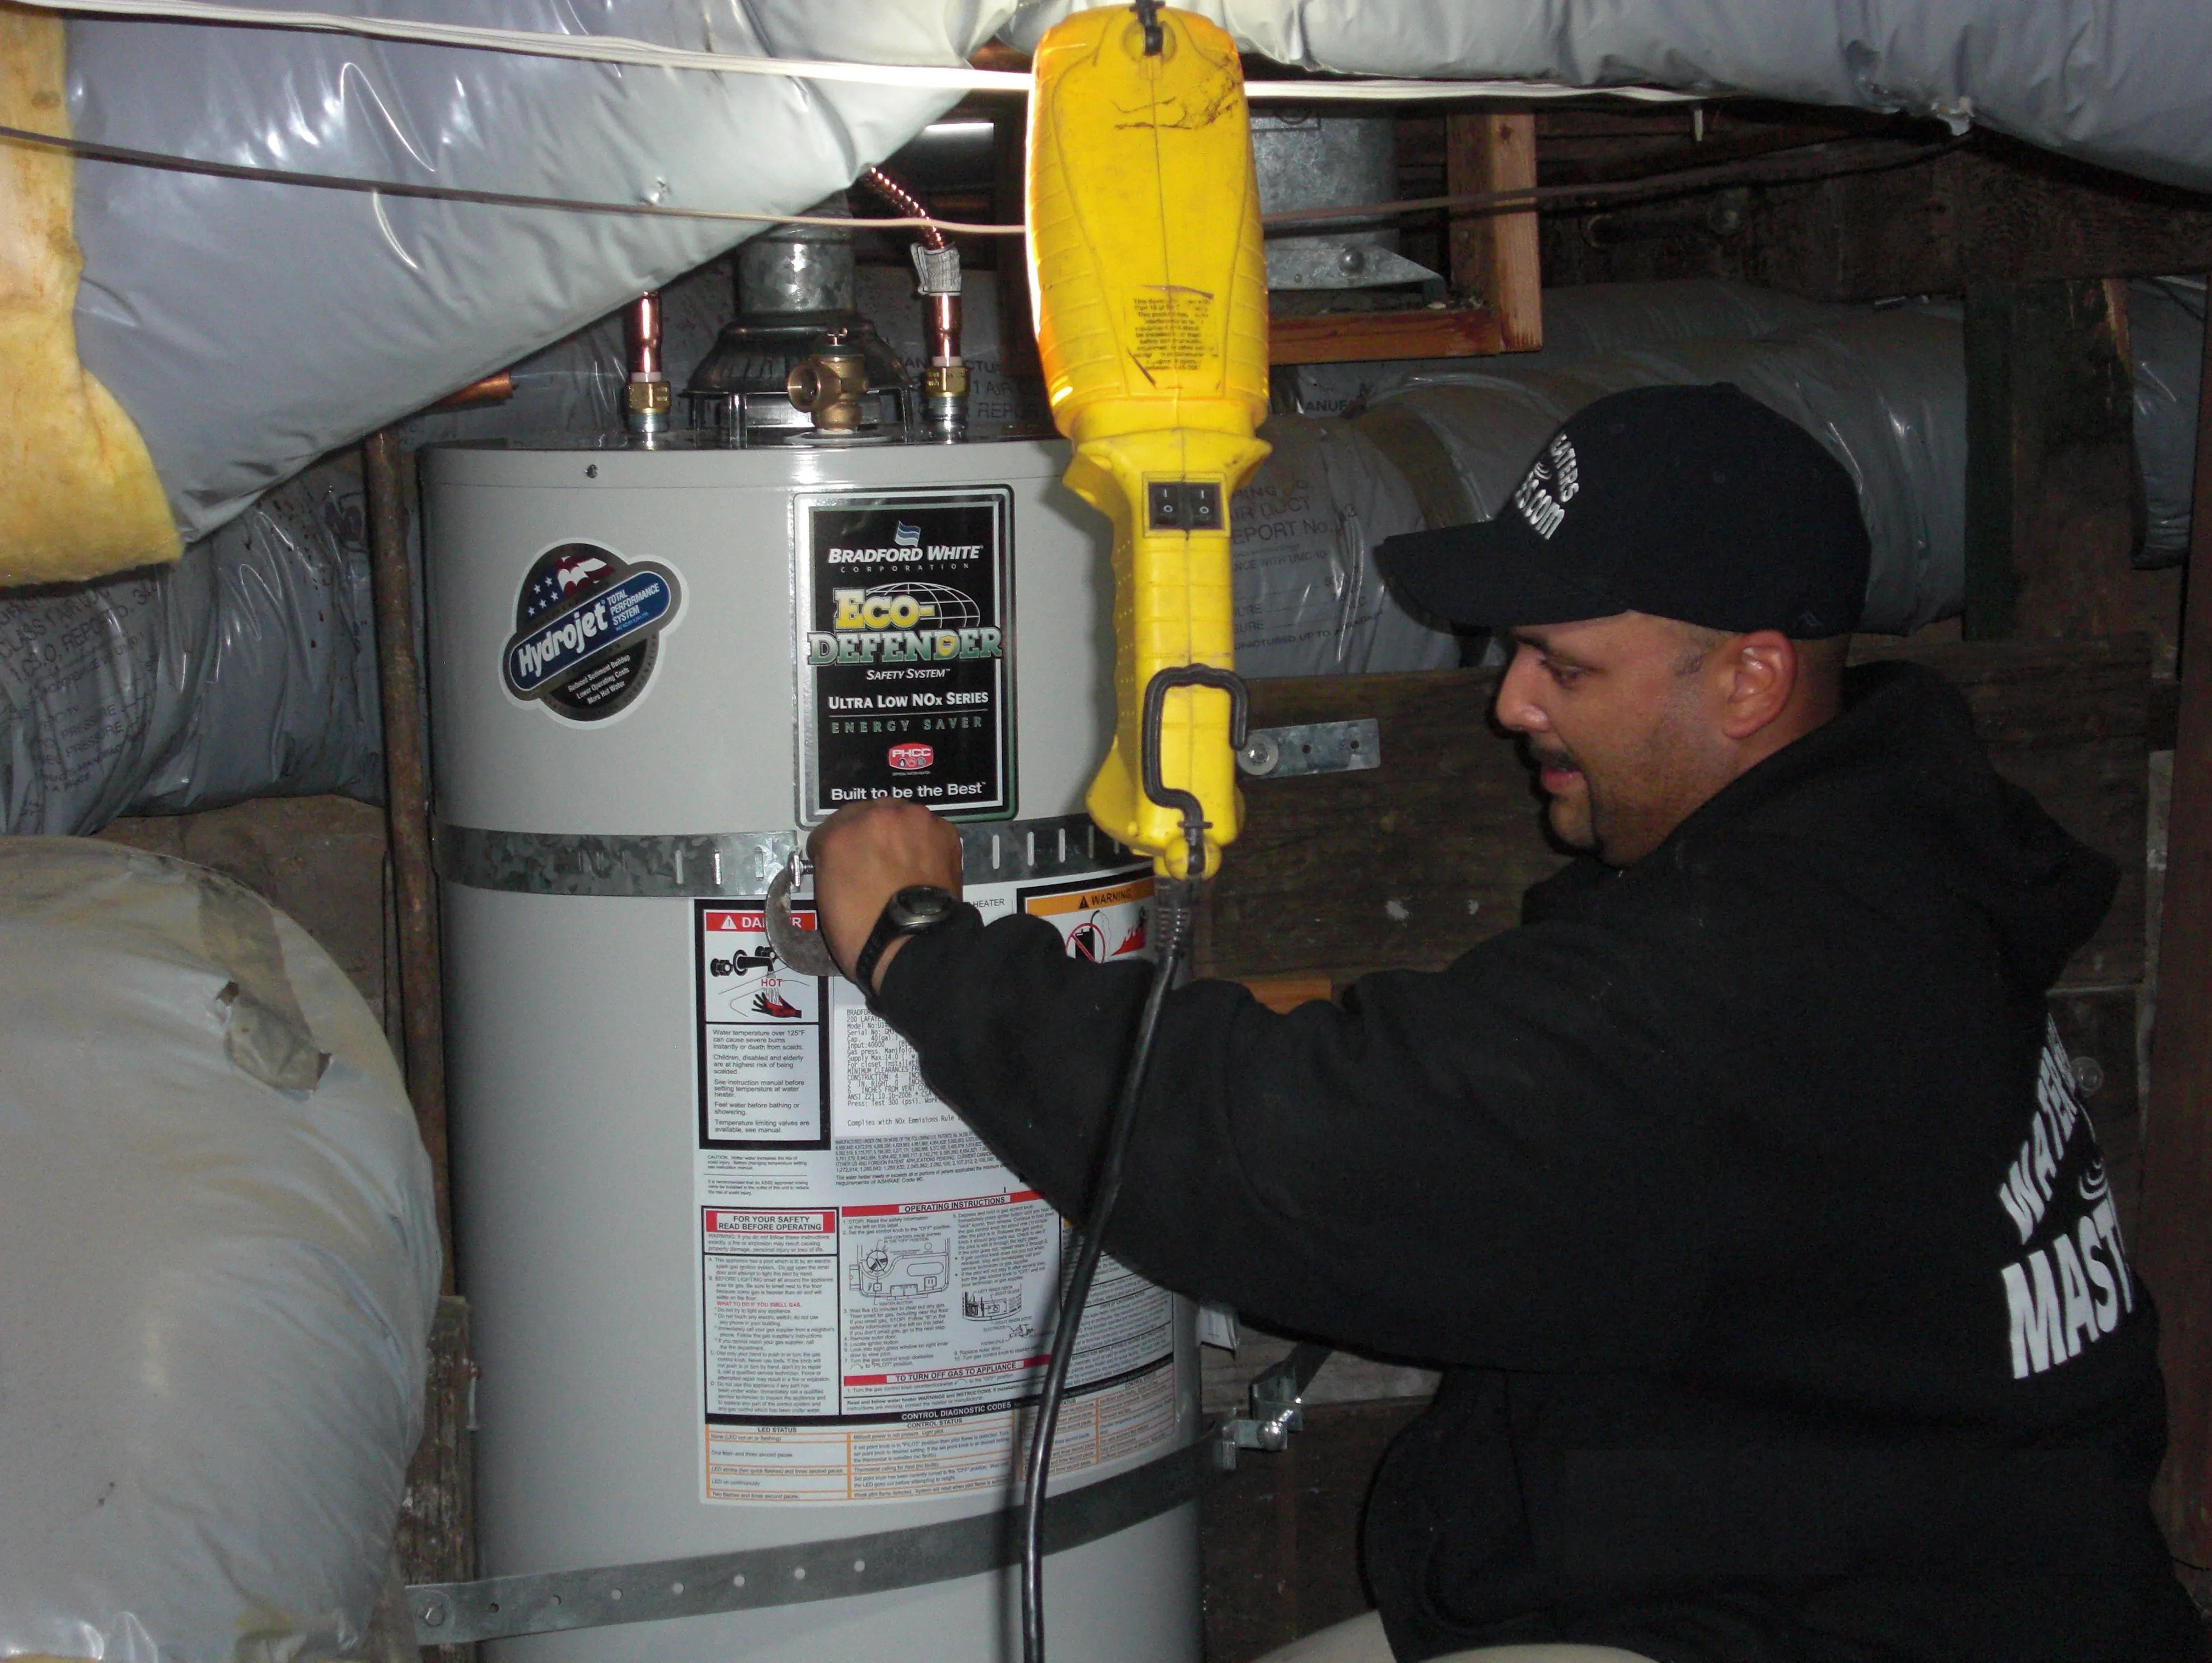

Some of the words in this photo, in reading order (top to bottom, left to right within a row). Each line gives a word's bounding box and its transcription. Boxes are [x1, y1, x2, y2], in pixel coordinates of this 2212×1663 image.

[828, 547, 923, 564] BRADFORD
[927, 545, 980, 560] WHITE
[840, 563, 969, 574] CORPORATION
[607, 590, 628, 605] TOTAL
[610, 583, 660, 616] PERFORMANCE
[613, 605, 640, 625] SYSTEM
[518, 602, 608, 677] Hydrojet
[807, 625, 1003, 666] DEFENDER
[615, 667, 630, 678] Costs
[867, 670, 904, 680] SAFETY
[828, 696, 872, 709] ULTRA
[877, 695, 908, 708] LOW
[946, 692, 989, 706] SERIES
[831, 720, 910, 734] ENERGY
[924, 716, 982, 731] SAVER
[891, 748, 932, 758] PHCC
[831, 788, 868, 801] Built
[871, 788, 888, 799] to
[892, 786, 913, 799] be
[917, 784, 943, 797] the
[973, 898, 1005, 908] HEATER
[1091, 888, 1132, 905] WARNING
[848, 1118, 875, 1128] Complies
[905, 1203, 949, 1213] OPERATING
[951, 1196, 1005, 1208] INSTRUCTIONS
[977, 1363, 1016, 1374] APPLIANCE
[941, 1405, 985, 1417] DIAGNOSTIC
[987, 1402, 1011, 1411] CODES
